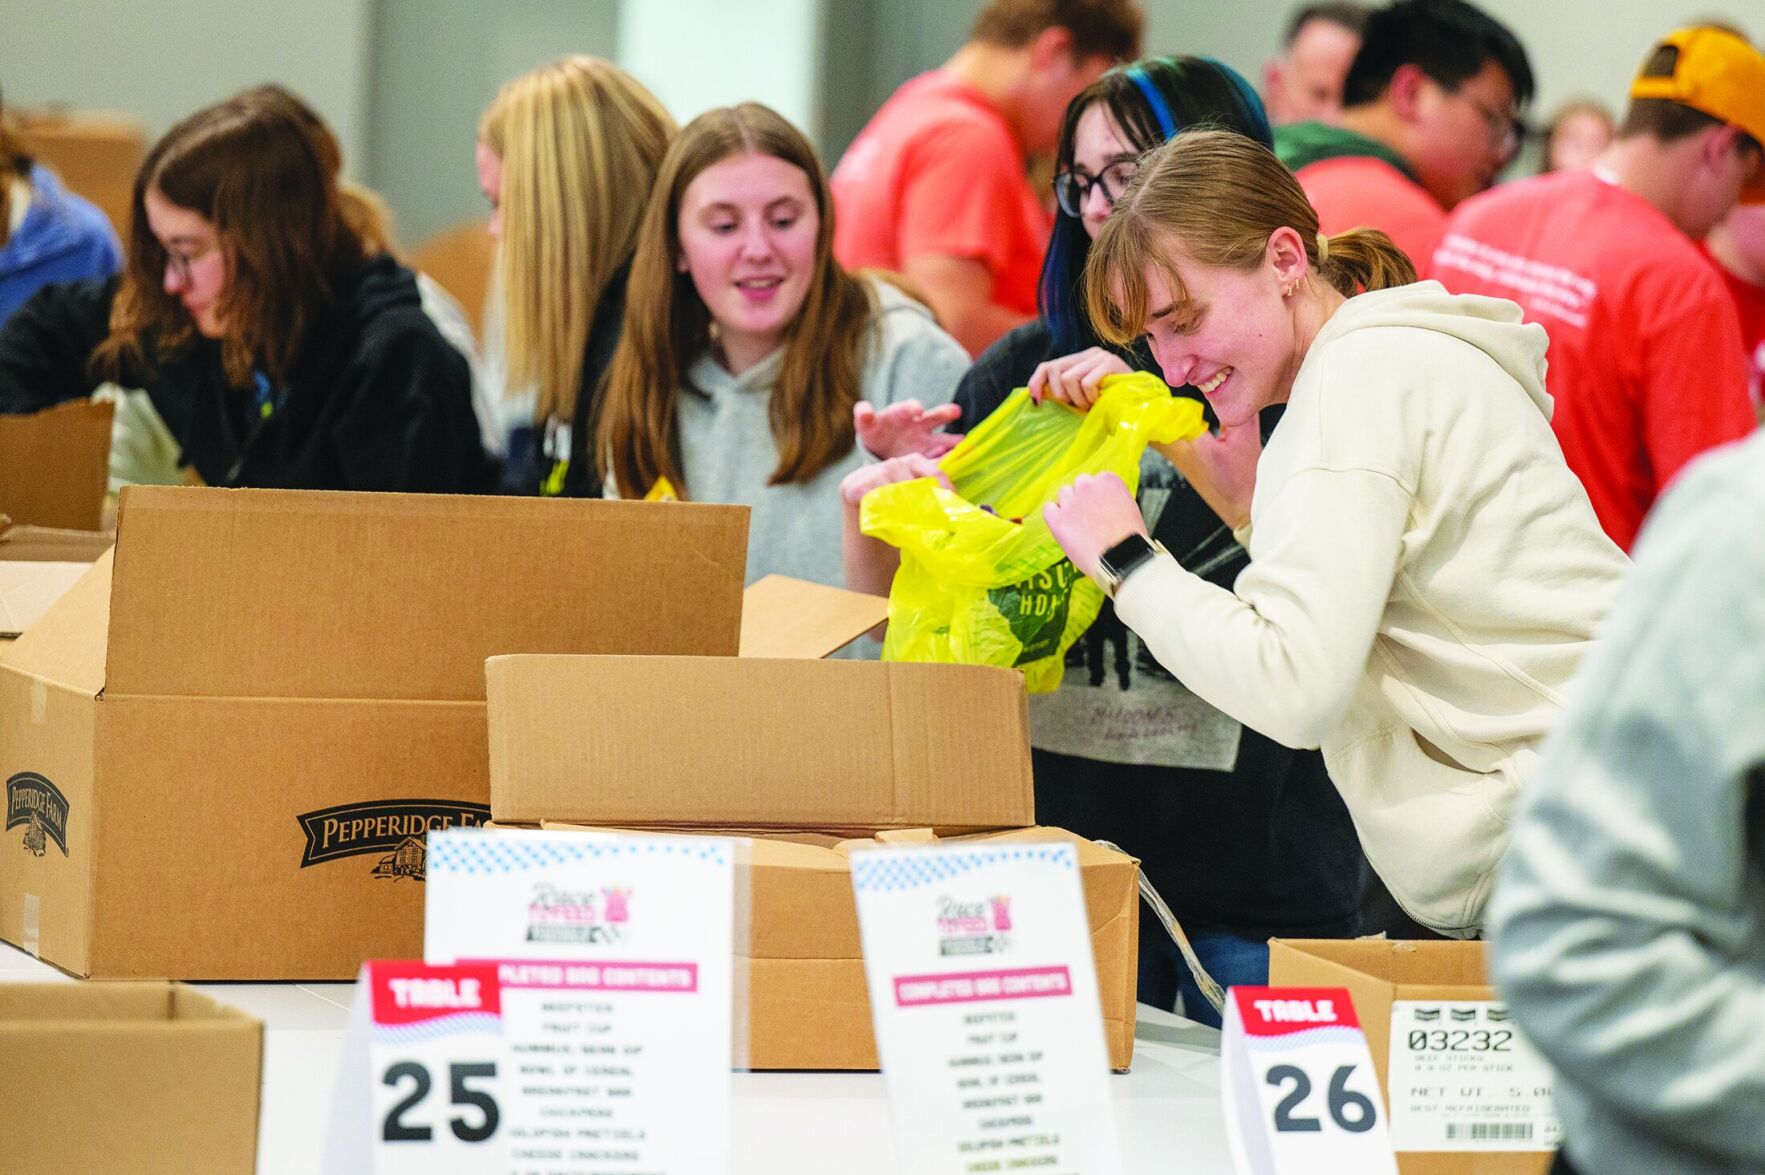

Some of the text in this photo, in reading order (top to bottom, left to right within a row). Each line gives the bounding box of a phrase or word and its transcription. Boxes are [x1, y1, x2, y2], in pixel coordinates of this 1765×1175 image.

[11, 786, 62, 832] PEPPERIDGE FARM
[322, 814, 453, 849] PEPPERIDGE
[388, 978, 482, 1009] TABLE
[1253, 1000, 1338, 1022] TABLE
[1409, 1030, 1513, 1051] 03232
[382, 1062, 500, 1142] 25
[1266, 1065, 1377, 1132] 26
[1411, 1087, 1447, 1097] NET
